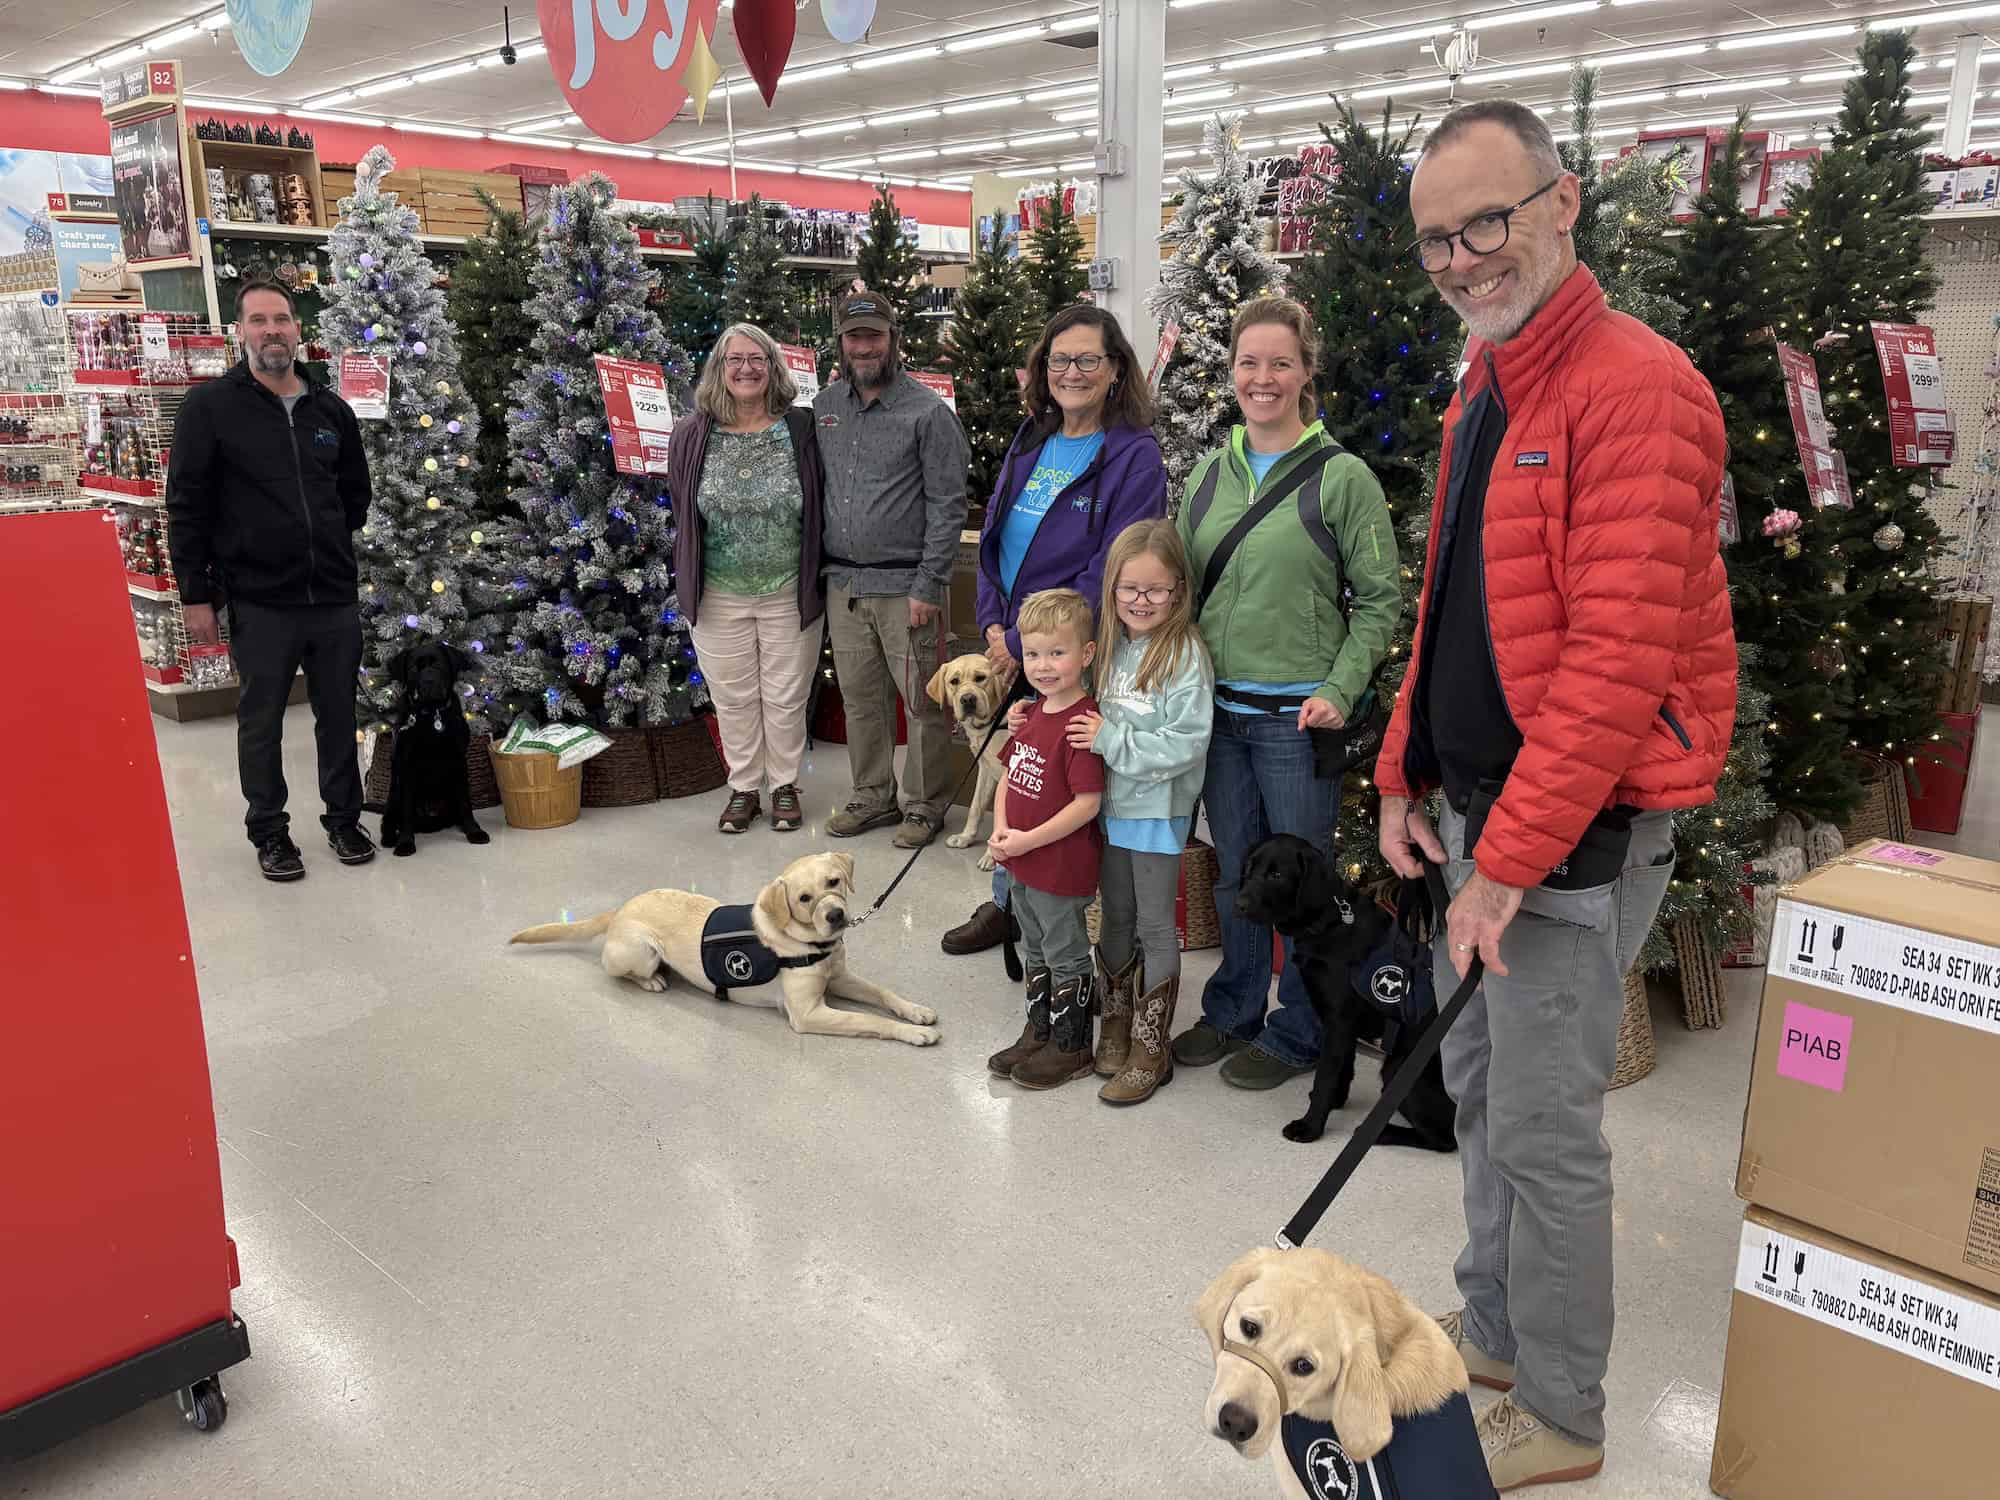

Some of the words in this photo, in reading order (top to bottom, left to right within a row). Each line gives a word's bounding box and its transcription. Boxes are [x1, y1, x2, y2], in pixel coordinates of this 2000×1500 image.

[568, 0, 689, 90] joy
[153, 71, 171, 86] 82
[51, 198, 63, 207] 78
[75, 200, 102, 209] Jewelry
[58, 231, 83, 240] Craft
[84, 232, 106, 241] your
[60, 240, 90, 249] charm
[91, 241, 118, 251] story.
[144, 314, 163, 323] Sale
[1907, 341, 1929, 354] Sale
[792, 358, 811, 371] Sale
[632, 373, 657, 387] Sale
[1032, 466, 1072, 484] DOGS
[1013, 769, 1043, 793] LIVES
[1902, 945, 1925, 971] SEA
[1927, 952, 1942, 975] 34
[1946, 956, 1971, 981] SET
[1972, 961, 1993, 987] WK
[1820, 969, 1845, 986] FRAGILE
[1849, 964, 1888, 993] 790882
[1889, 973, 1930, 1003] D-PIAB
[1930, 984, 1957, 1010] ASH
[1958, 991, 1986, 1017] ORN
[1786, 1028, 1842, 1061] PIAB
[1783, 1289, 1806, 1308] FRAGILE
[1859, 1278, 1881, 1304] SEA
[1883, 1287, 1896, 1309] 34
[1900, 1293, 1924, 1319] SET
[1925, 1300, 1944, 1327] WK
[1944, 1309, 1959, 1333] 34
[1811, 1289, 1847, 1318] 790882
[1849, 1303, 1886, 1333] D-PIAB
[1886, 1317, 1911, 1344] ASH
[1912, 1326, 1937, 1353] ORN
[1938, 1336, 1995, 1375] FEMININE
